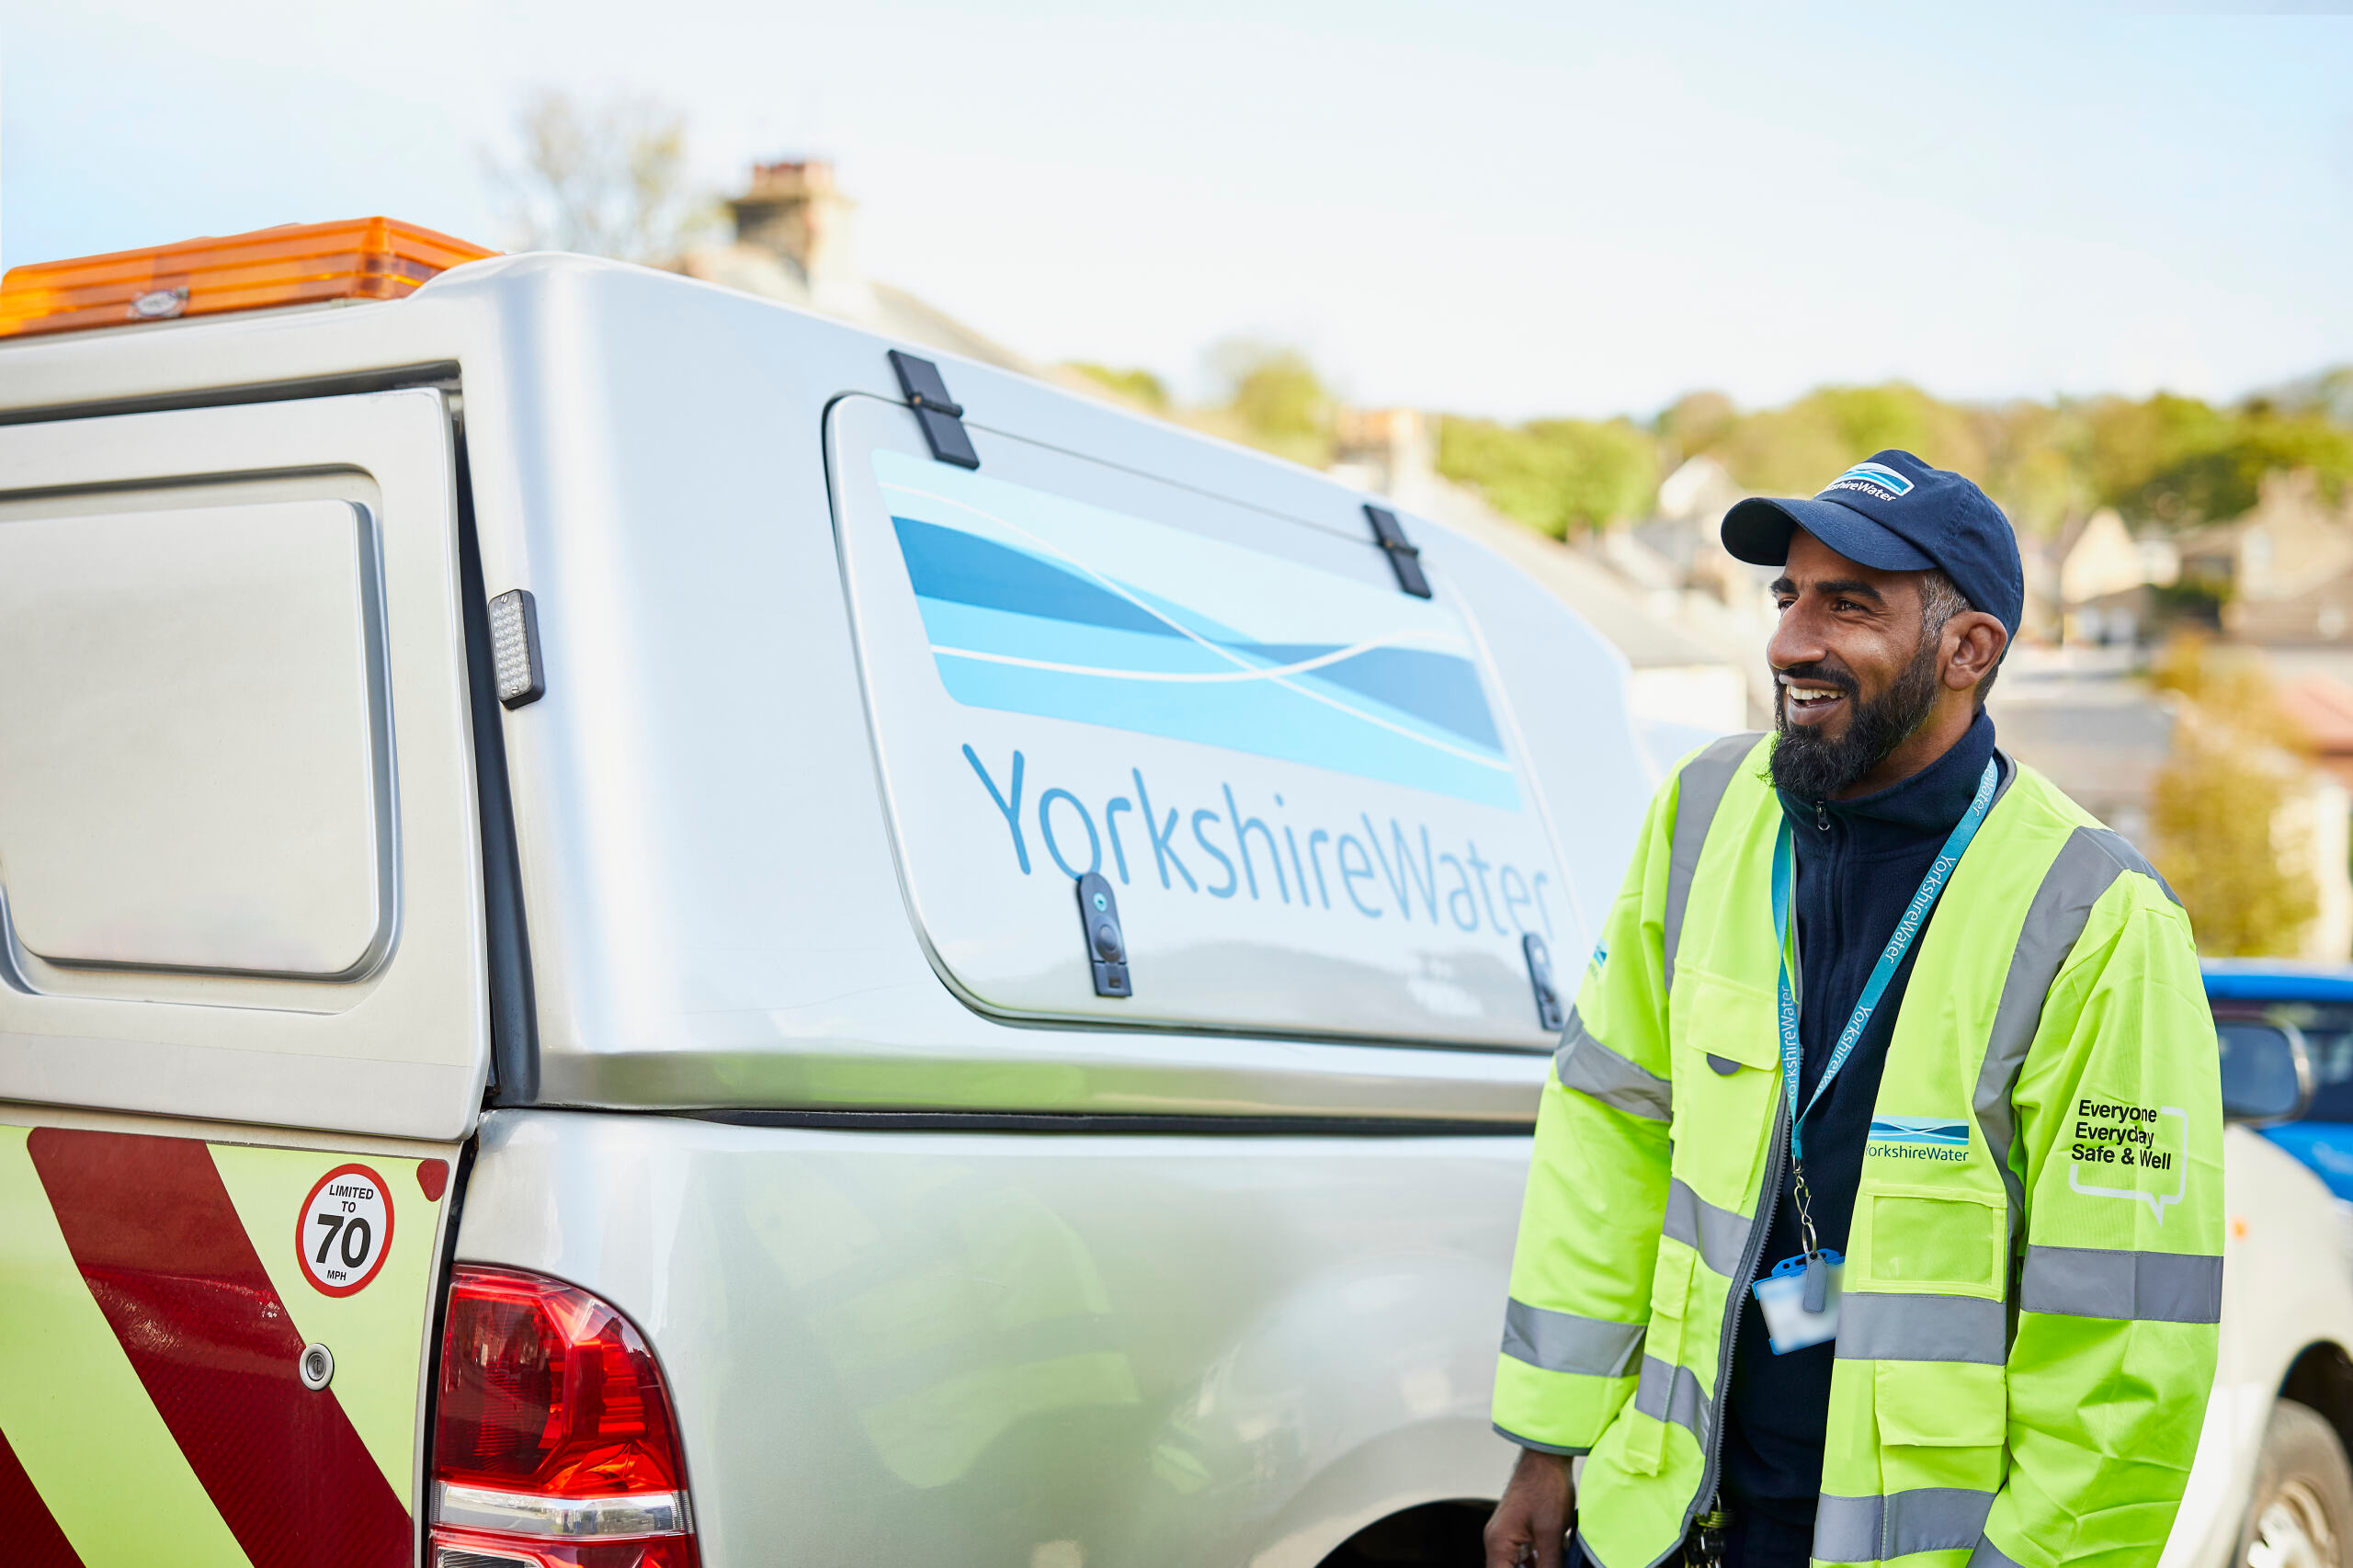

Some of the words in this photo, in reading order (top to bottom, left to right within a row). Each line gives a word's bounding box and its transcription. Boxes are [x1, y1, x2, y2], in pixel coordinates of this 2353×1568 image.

[961, 743, 1553, 941] YorkshireWater
[1884, 855, 1957, 964] YorkshireWater
[1780, 984, 1798, 1104] YorkshireWater
[2078, 1099, 2157, 1124] Everyone
[2075, 1121, 2154, 1150] Everyday
[2071, 1143, 2116, 1164] Safe
[2120, 1147, 2135, 1165] &
[2140, 1149, 2171, 1170] Well
[329, 1184, 374, 1200] LIMITED
[341, 1200, 357, 1213] TO
[315, 1213, 371, 1268] 70
[326, 1269, 347, 1281] MPH
